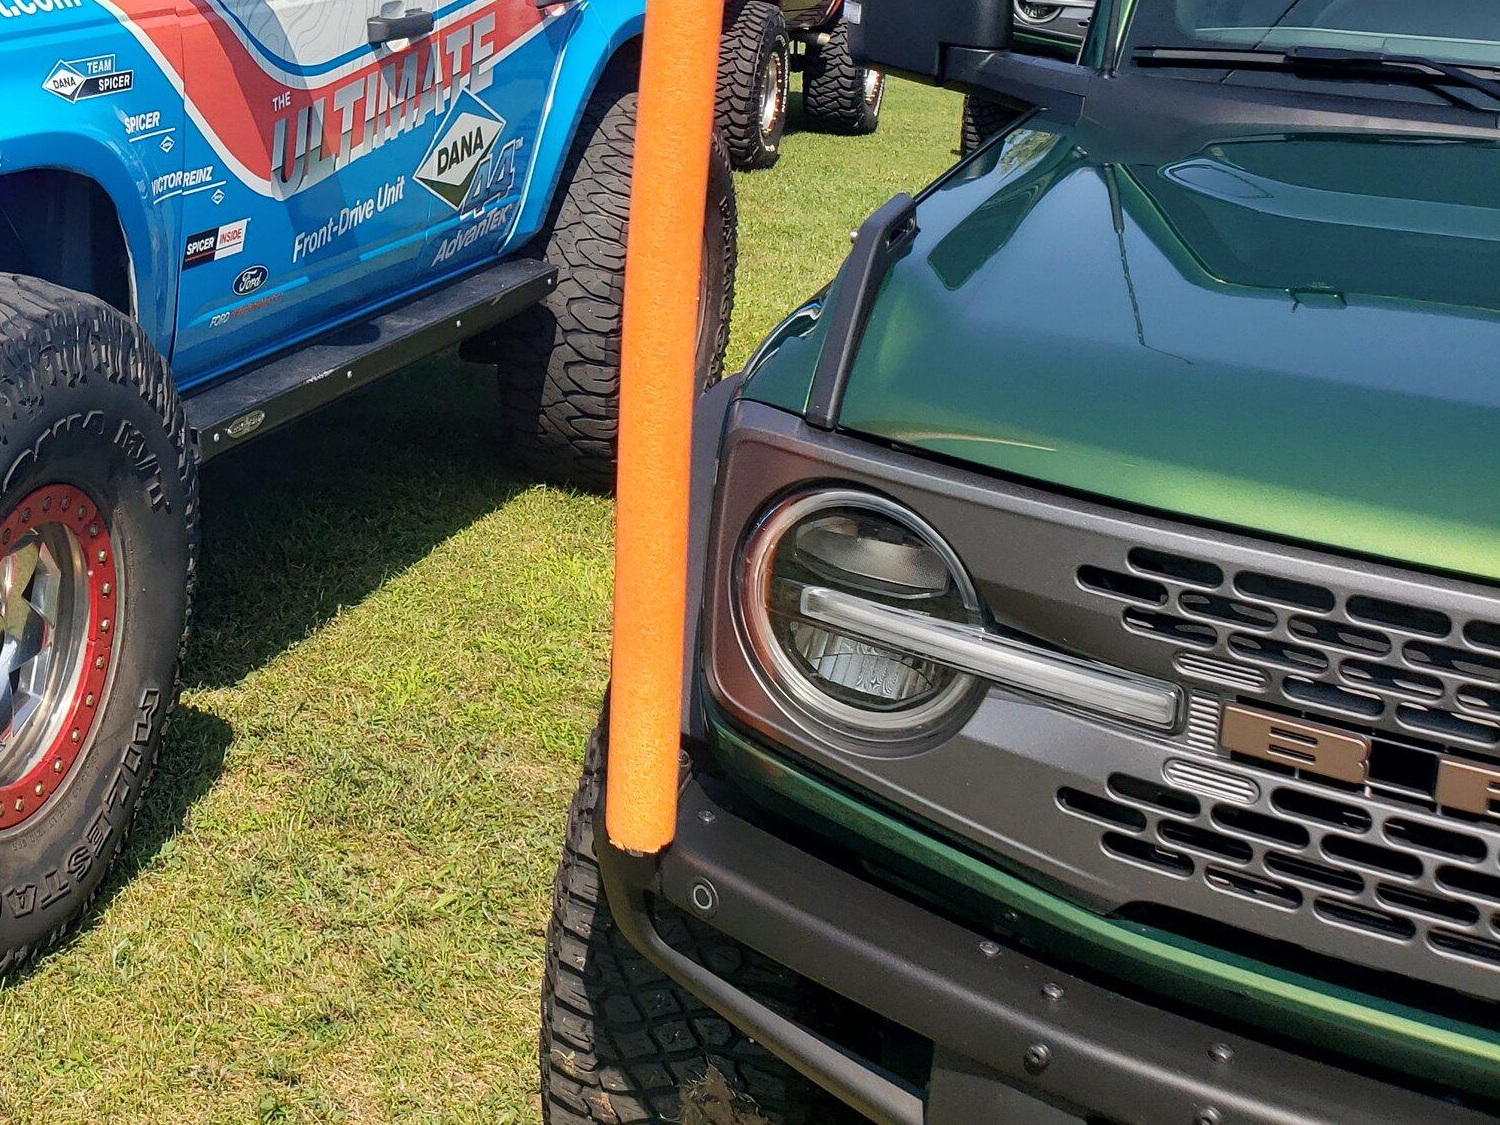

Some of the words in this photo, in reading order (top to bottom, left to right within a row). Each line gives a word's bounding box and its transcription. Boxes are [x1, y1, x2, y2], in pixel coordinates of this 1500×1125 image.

[87, 59, 112, 74] TEAM
[52, 76, 77, 90] DANA
[98, 74, 130, 91] SPICER
[271, 11, 496, 202] ULTIMATE
[272, 91, 291, 112] THE
[124, 111, 160, 135] SPICER
[436, 125, 485, 177] DANA
[182, 166, 213, 188] REINZ
[293, 193, 374, 263] Front-Drive
[376, 175, 405, 212] Unit
[186, 236, 216, 256] SPICER
[219, 228, 243, 244] INSIDE
[238, 268, 263, 292] Ford
